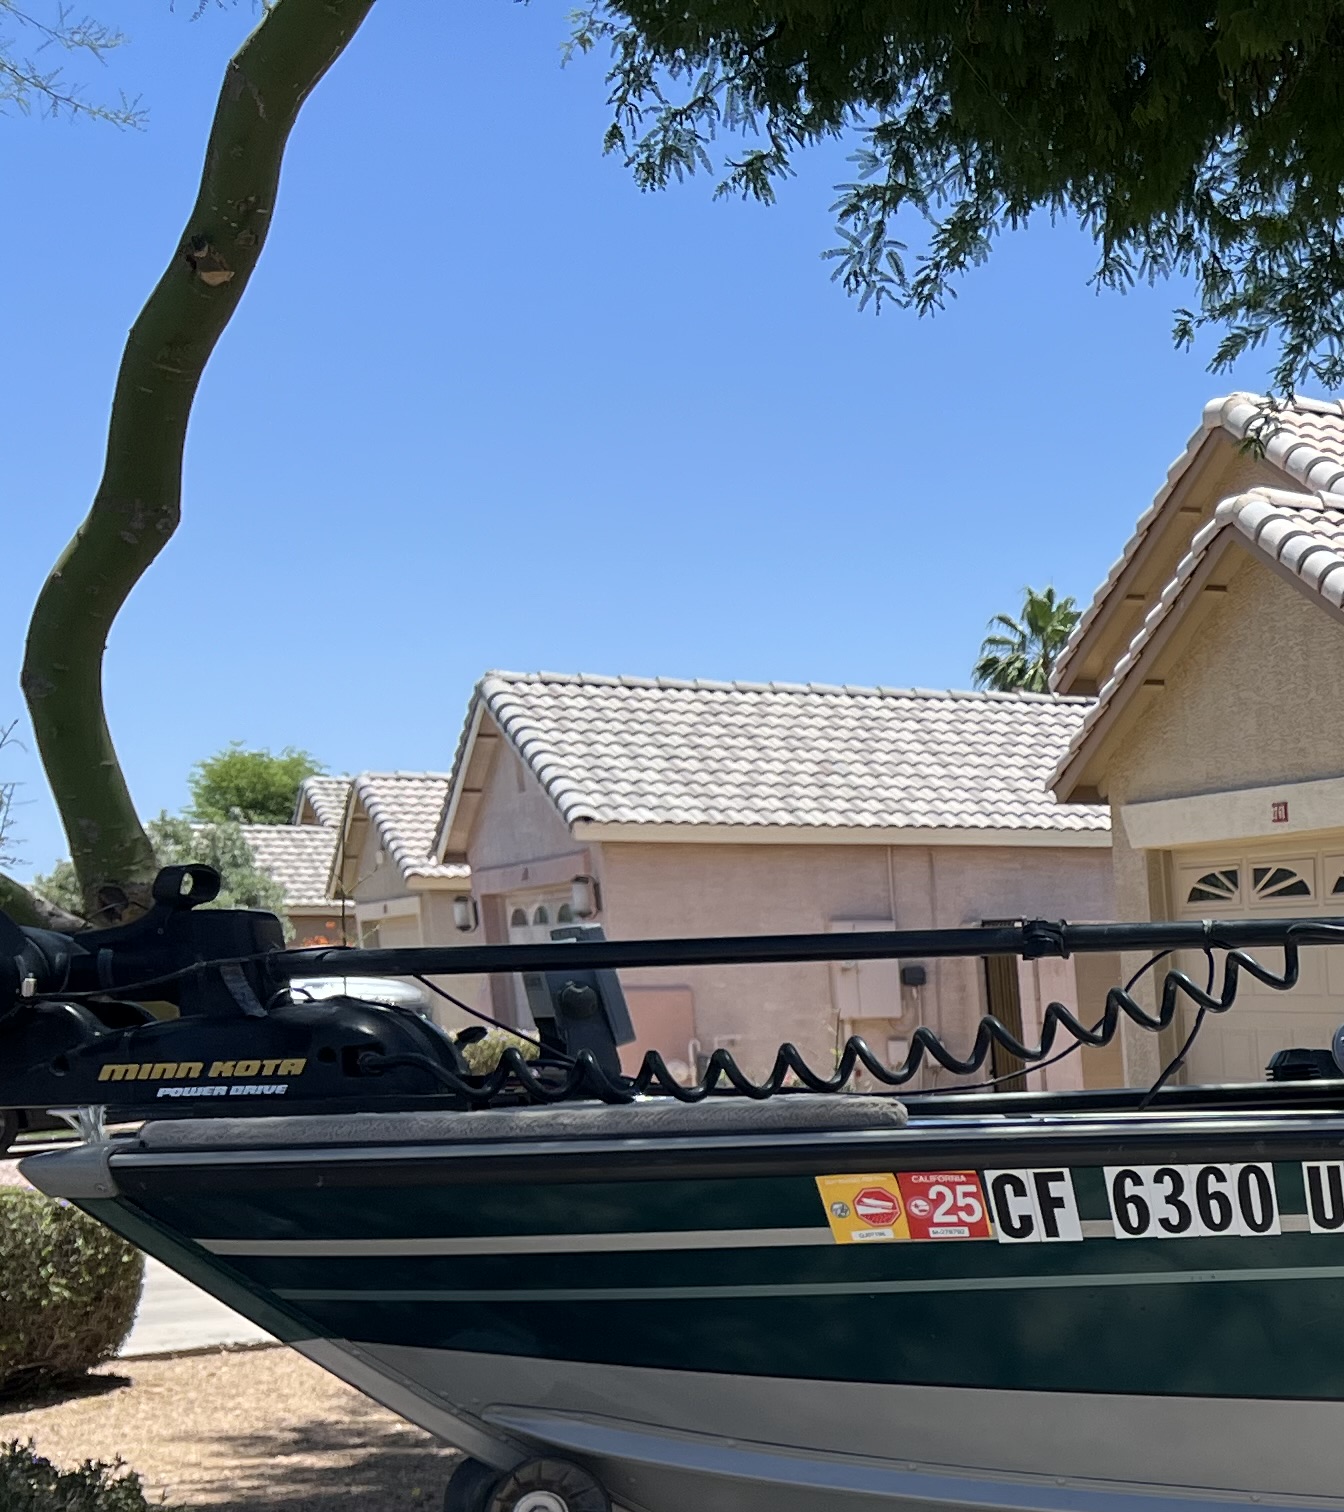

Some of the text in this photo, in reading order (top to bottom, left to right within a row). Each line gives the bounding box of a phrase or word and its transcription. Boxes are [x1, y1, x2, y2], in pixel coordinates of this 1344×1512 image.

[98, 1058, 307, 1081] MINN KOTA
[156, 1084, 288, 1097] POWER DRIVE
[911, 1174, 967, 1183] CALIFORNIA
[928, 1184, 983, 1223] 25
[991, 1170, 1067, 1239] CF
[1112, 1163, 1275, 1236] 6360
